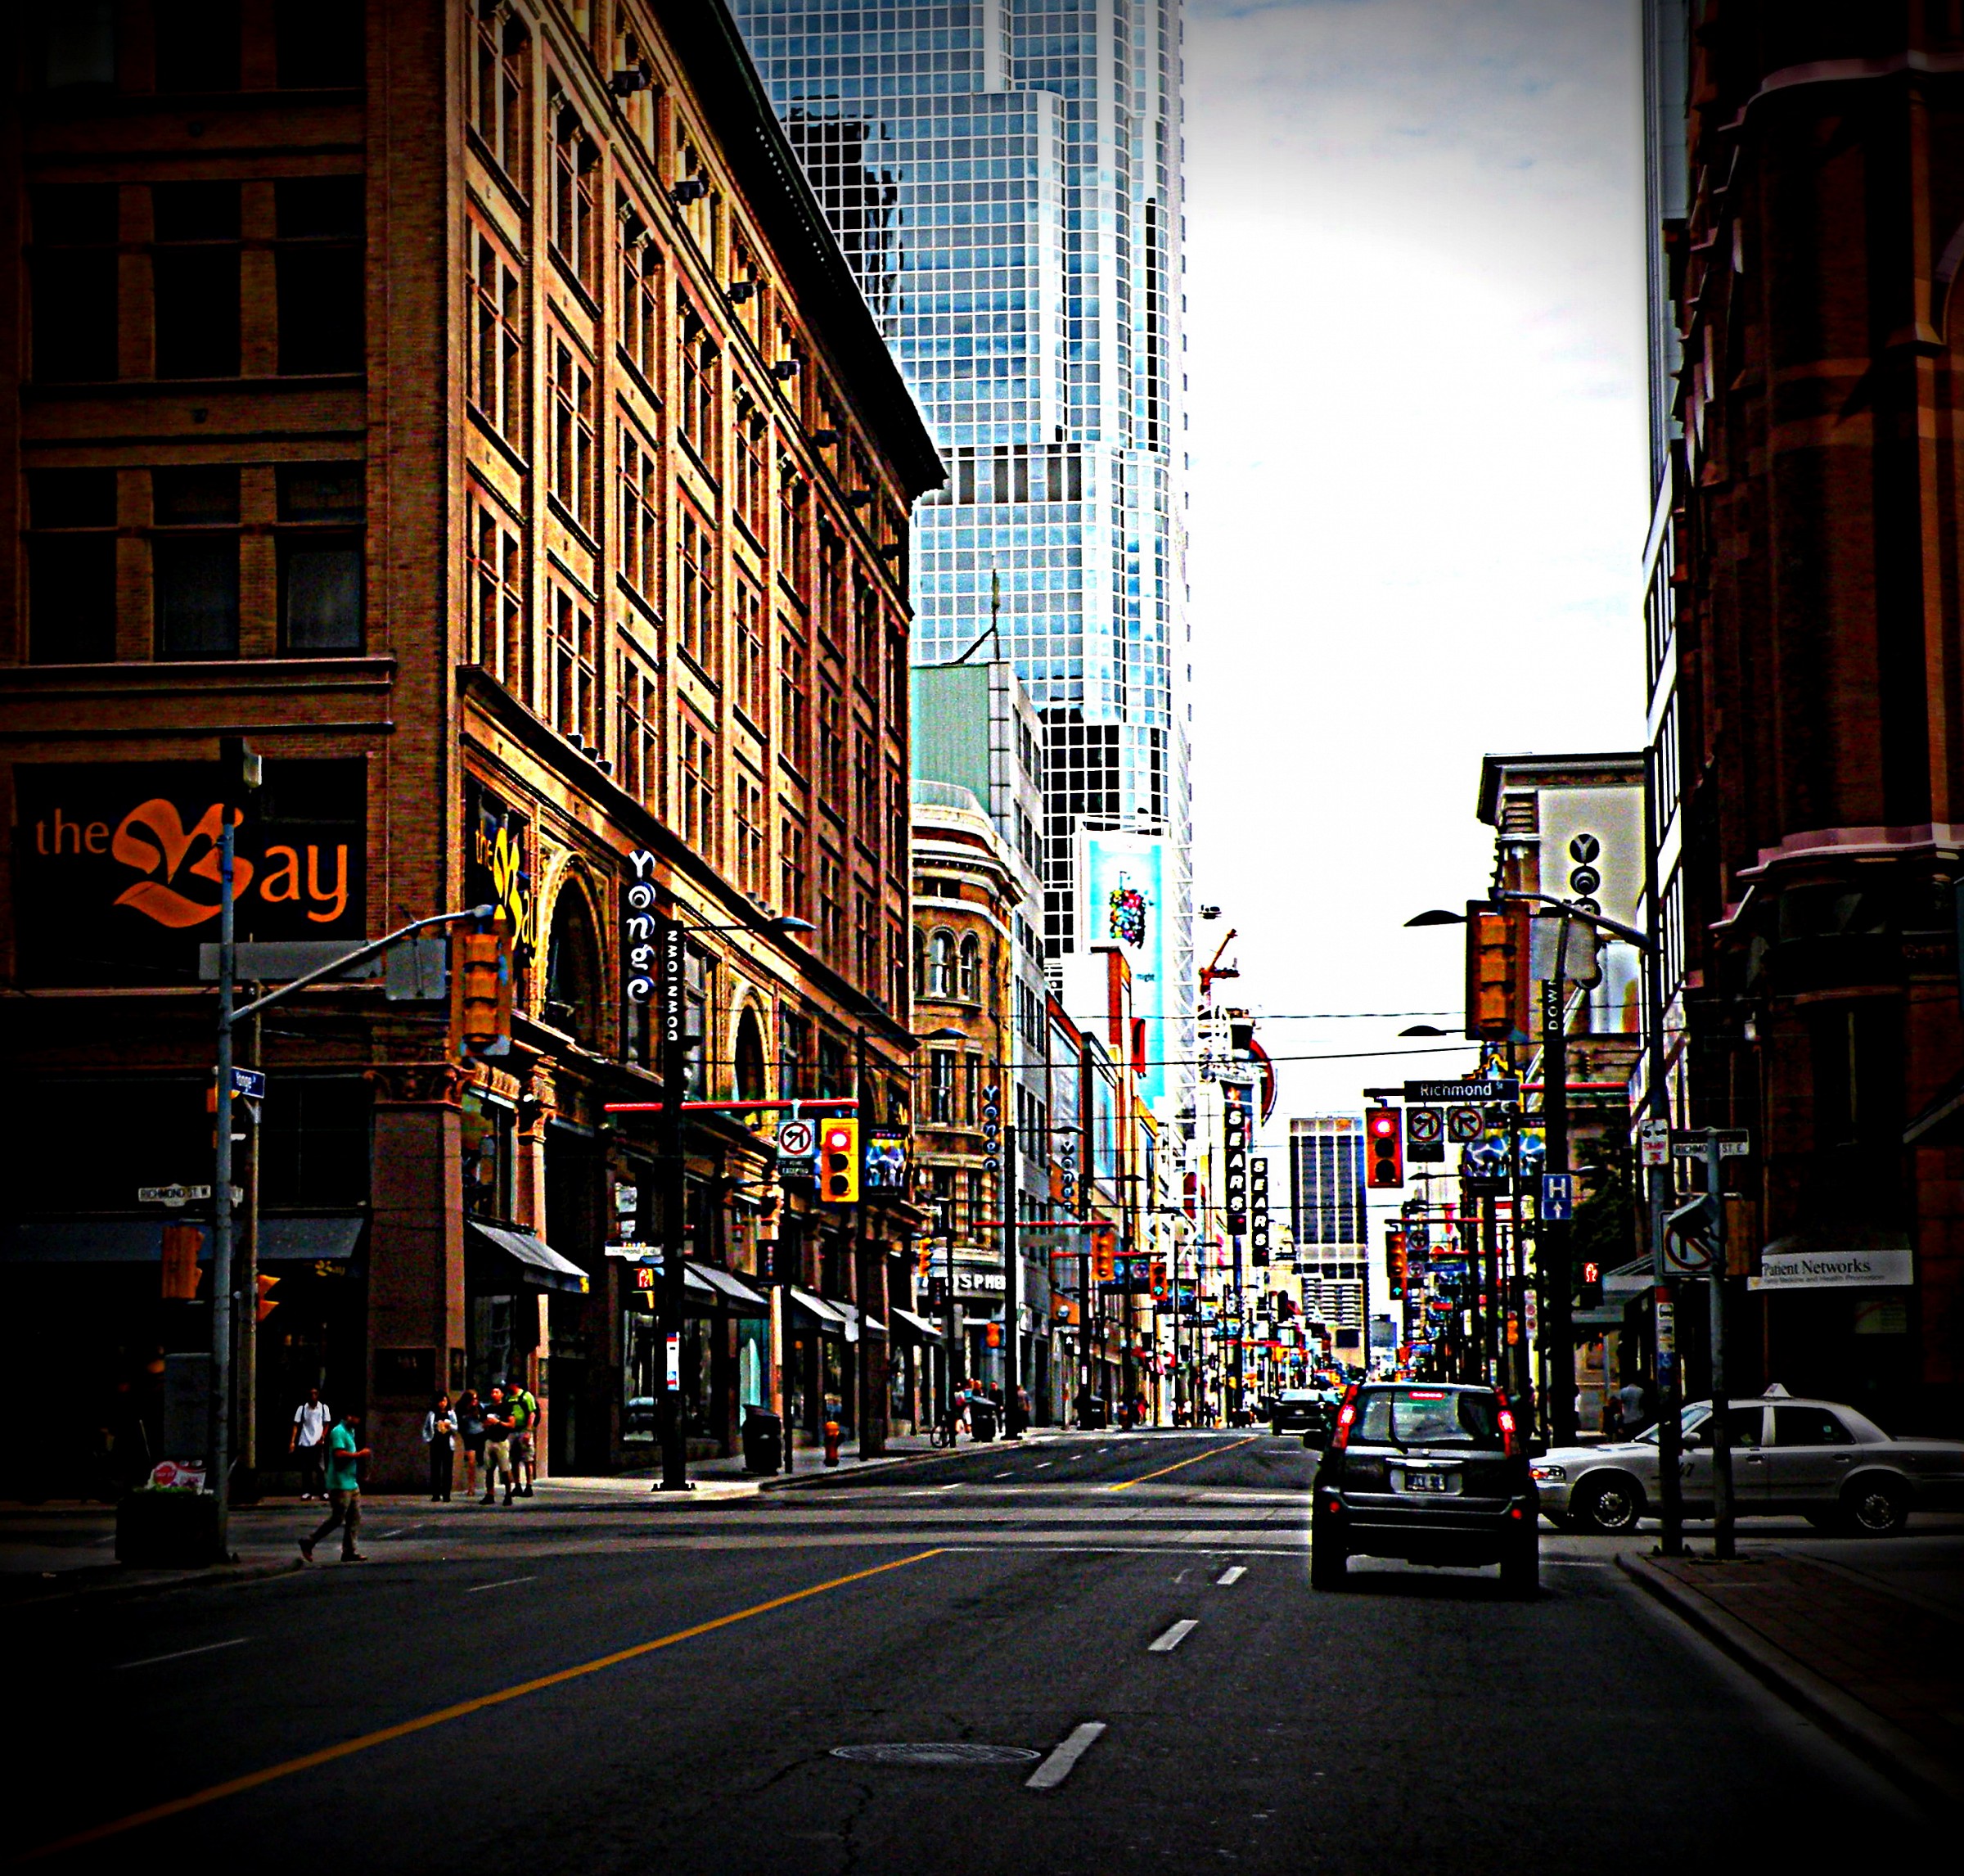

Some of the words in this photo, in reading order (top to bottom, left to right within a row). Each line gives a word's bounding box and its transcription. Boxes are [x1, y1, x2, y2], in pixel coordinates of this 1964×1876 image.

[36, 808, 110, 855] the
[112, 798, 349, 929] Bay
[627, 850, 655, 1003] Yonge
[667, 931, 678, 1041] DOWNTOWN
[1548, 980, 1559, 1030] DOW
[983, 1085, 999, 1171] Yonge
[1421, 1082, 1493, 1097] Richmond
[1229, 1110, 1244, 1211] SEARS
[1548, 1178, 1566, 1199] H
[1675, 1145, 1708, 1154] RICHMO
[1253, 1160, 1267, 1246] SEARS
[1763, 1262, 1798, 1276] Patient
[1802, 1258, 1872, 1275] Networks
